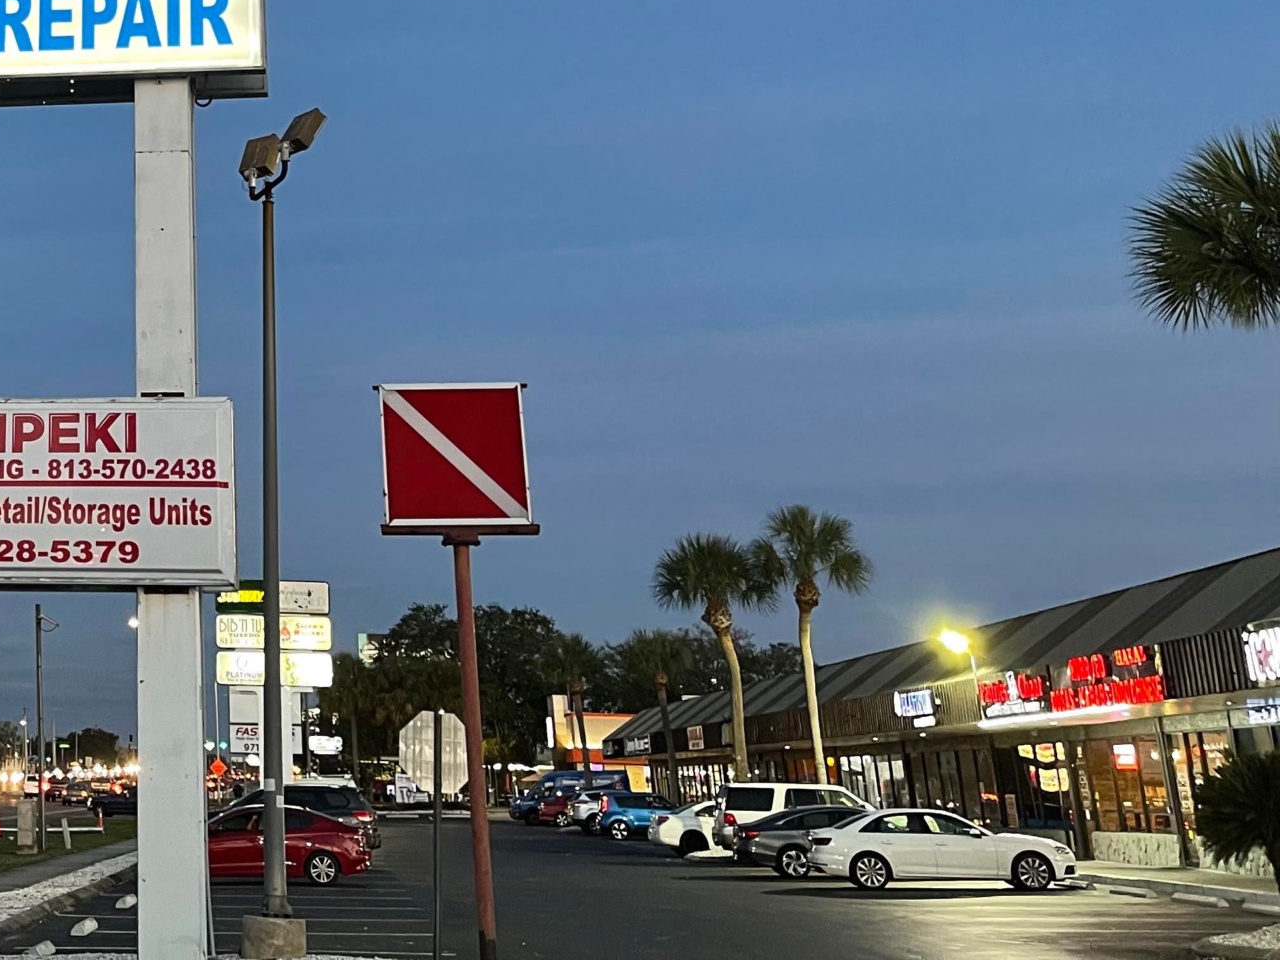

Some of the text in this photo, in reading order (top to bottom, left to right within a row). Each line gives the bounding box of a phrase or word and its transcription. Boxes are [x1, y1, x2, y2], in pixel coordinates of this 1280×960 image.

[47, 458, 216, 480] 813-570-2438
[149, 497, 213, 526] Units
[251, 618, 264, 633] TU
[236, 727, 259, 736] FAS
